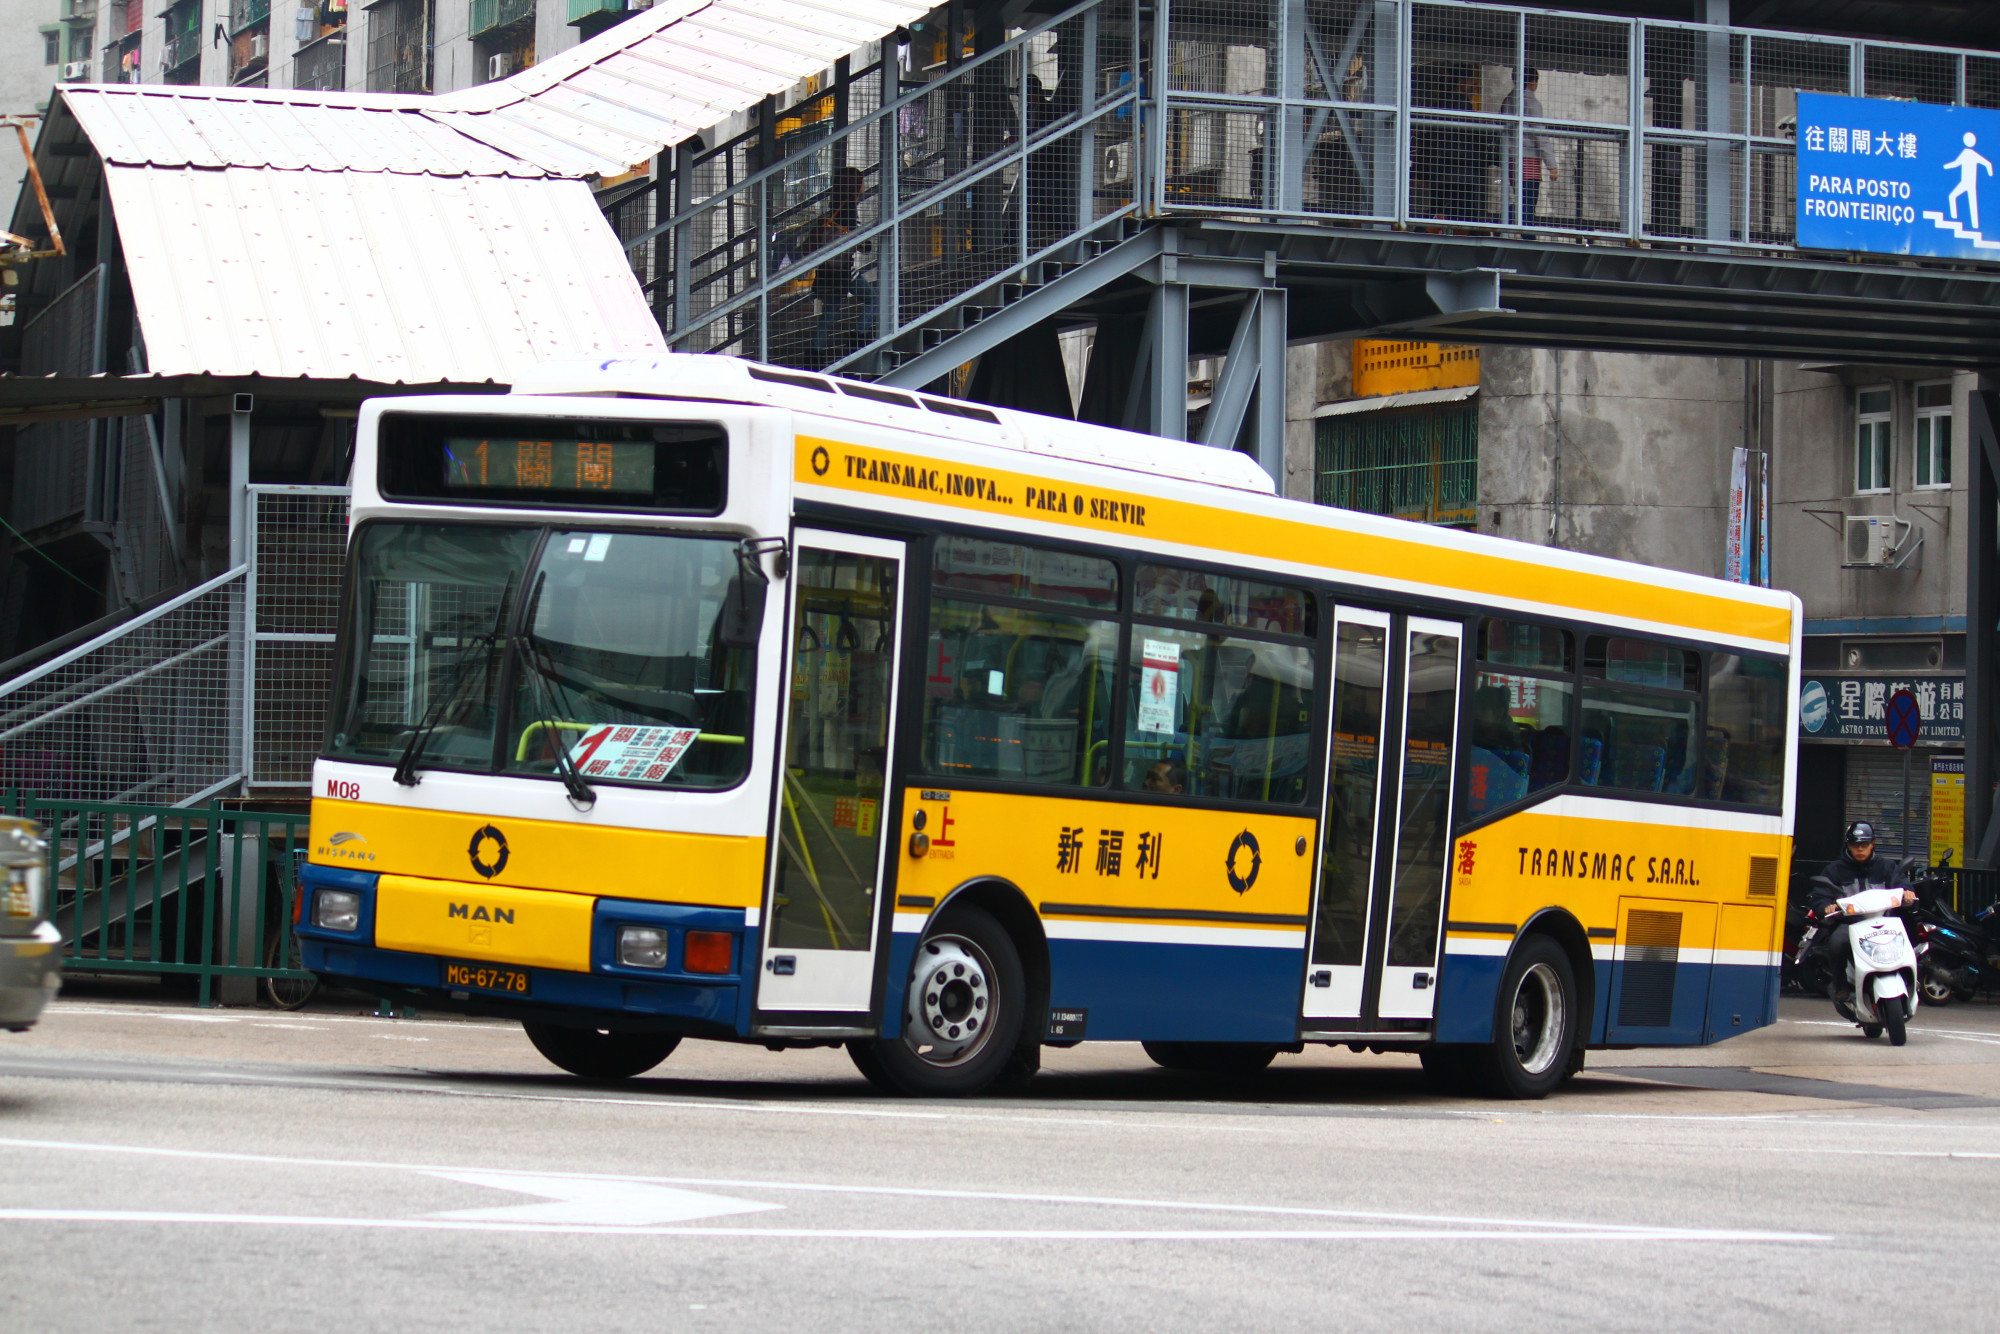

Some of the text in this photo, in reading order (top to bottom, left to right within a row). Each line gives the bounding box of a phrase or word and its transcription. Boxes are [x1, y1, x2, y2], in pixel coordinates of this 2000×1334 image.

[1805, 126, 1917, 158] 往關閘大樓
[1810, 175, 1911, 199] PARA POSTO
[1805, 199, 1915, 225] FRONTEIRIÇO
[474, 440, 488, 485] 1
[1025, 487, 1067, 513] PARA
[1074, 495, 1084, 516] O
[1090, 498, 1145, 526] SERVIR
[1840, 680, 1936, 721] 星際遊
[1840, 725, 1863, 735] ASTRO
[1866, 725, 1888, 736] TRAVE
[1931, 726, 1961, 737] LIMITED
[573, 726, 615, 771] 1
[328, 779, 360, 800] M08
[932, 806, 955, 847] 上
[318, 846, 376, 861] HISPANO
[1056, 826, 1162, 880] 新福利
[1458, 841, 1477, 875] 落
[1519, 847, 1700, 886] TRANSMAC S.A.R.L.
[448, 902, 515, 925] MAN
[447, 964, 527, 992] MG-67-78
